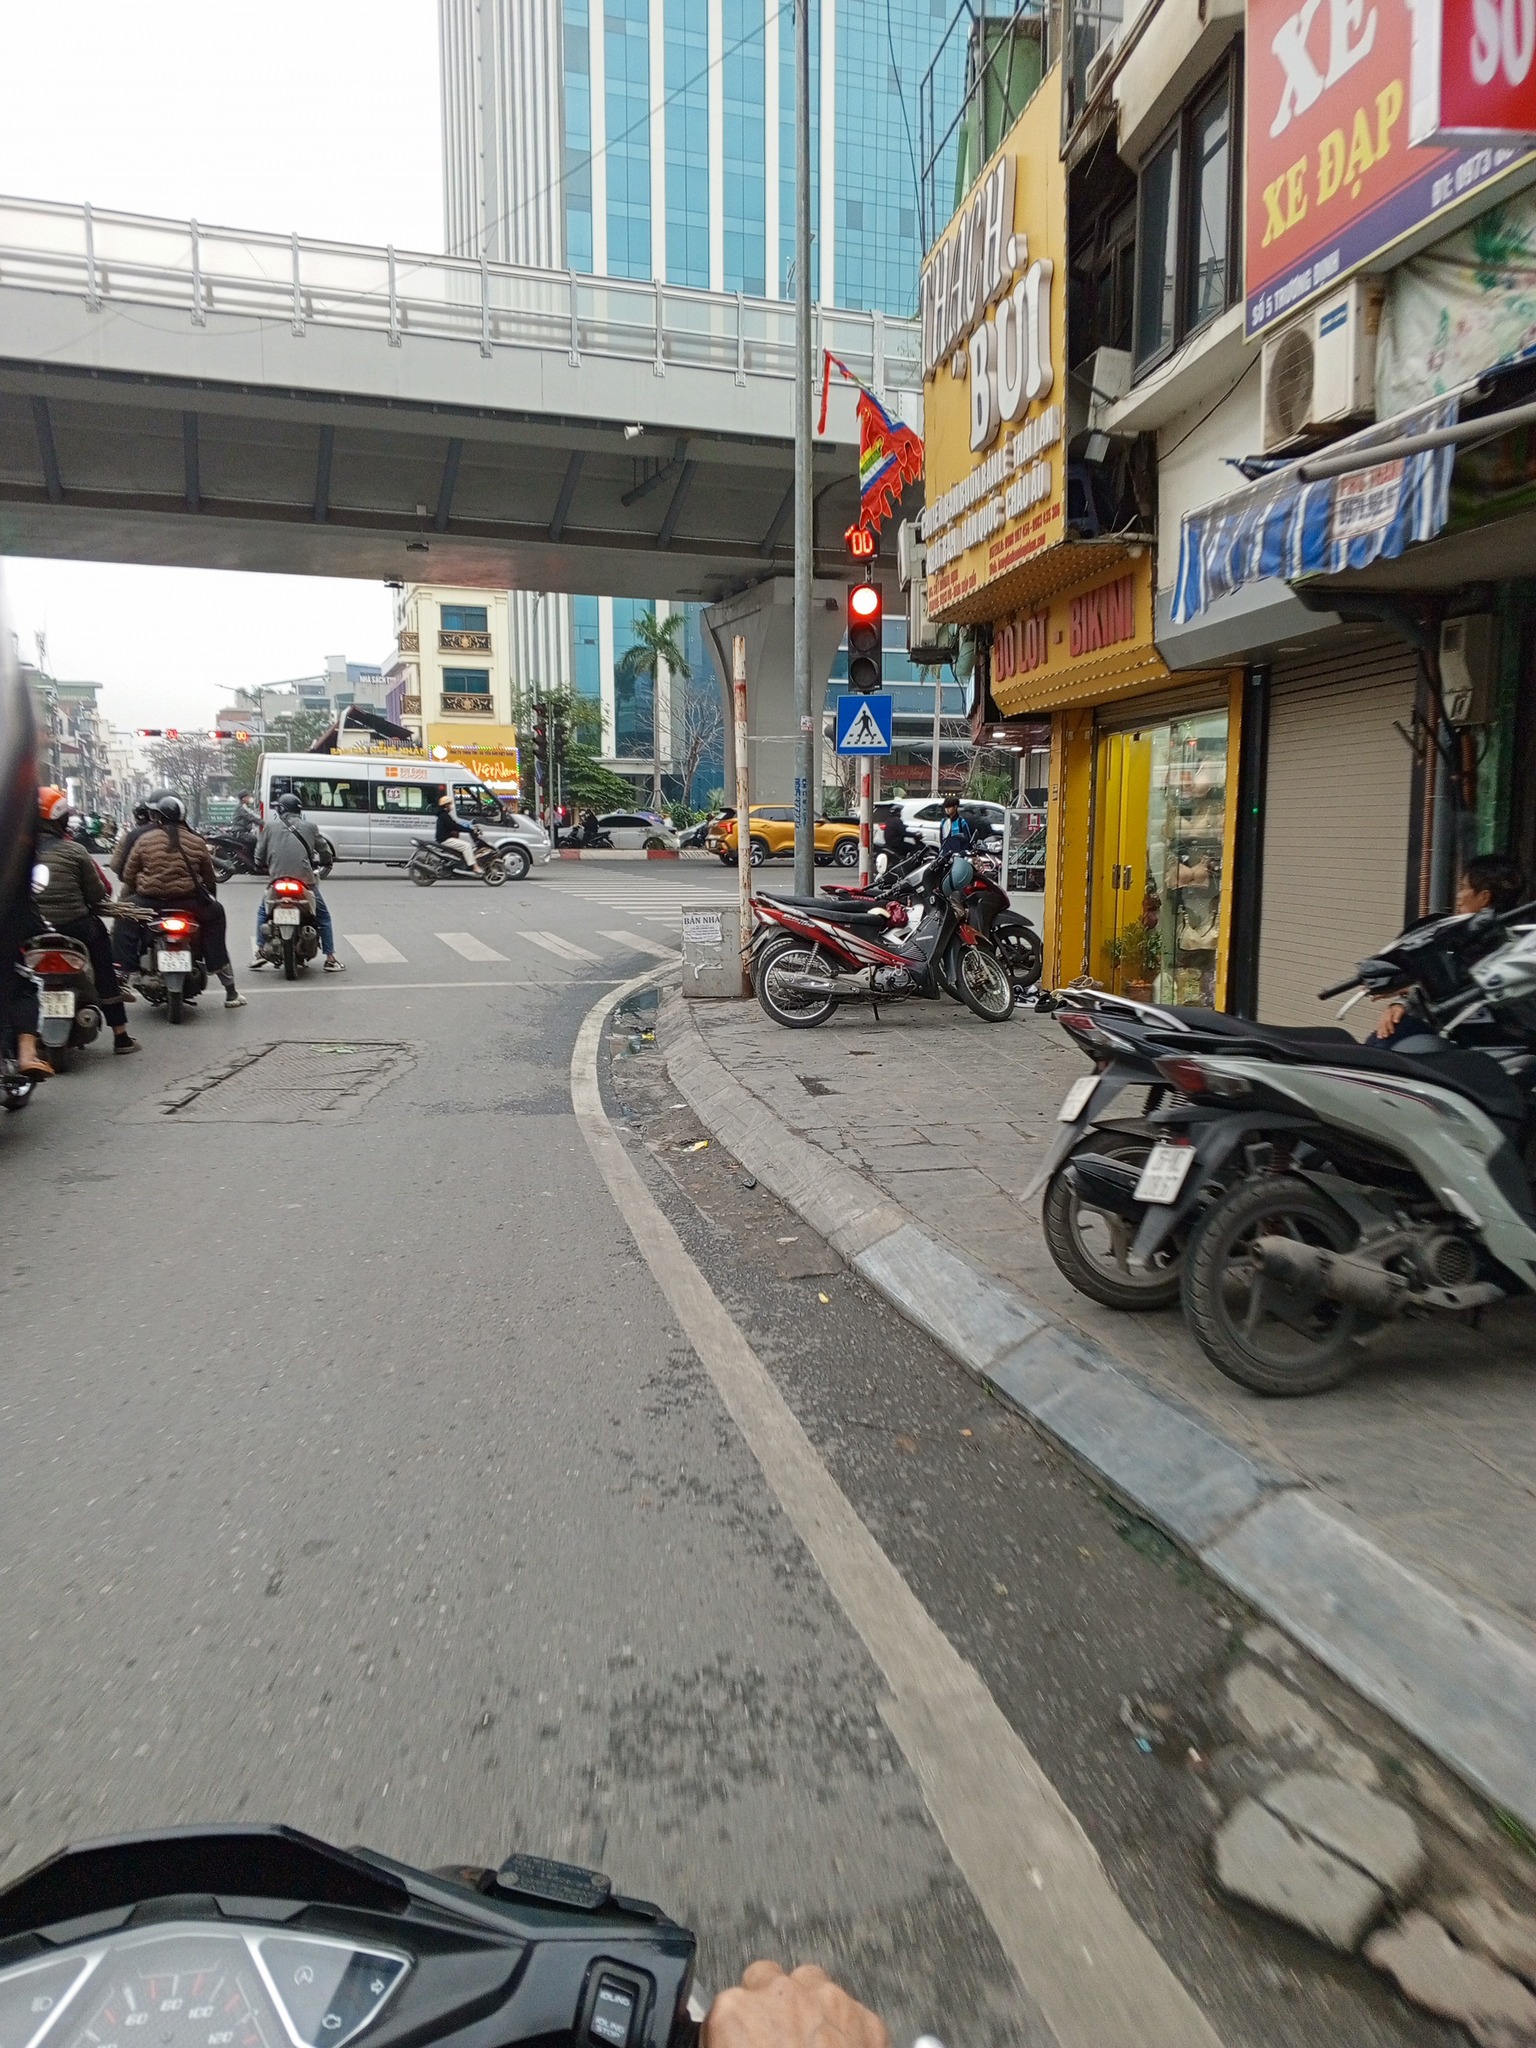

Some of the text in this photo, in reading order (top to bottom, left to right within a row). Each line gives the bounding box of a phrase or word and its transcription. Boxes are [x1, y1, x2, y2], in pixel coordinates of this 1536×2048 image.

[1261, 78, 1404, 249] XE ĐẠP
[921, 153, 1010, 382] THẠCH
[1265, 295, 1273, 318] 5
[1069, 573, 1135, 658] BIKINI
[188, 2004, 215, 2019] 100
[600, 1990, 631, 2007] IDLING
